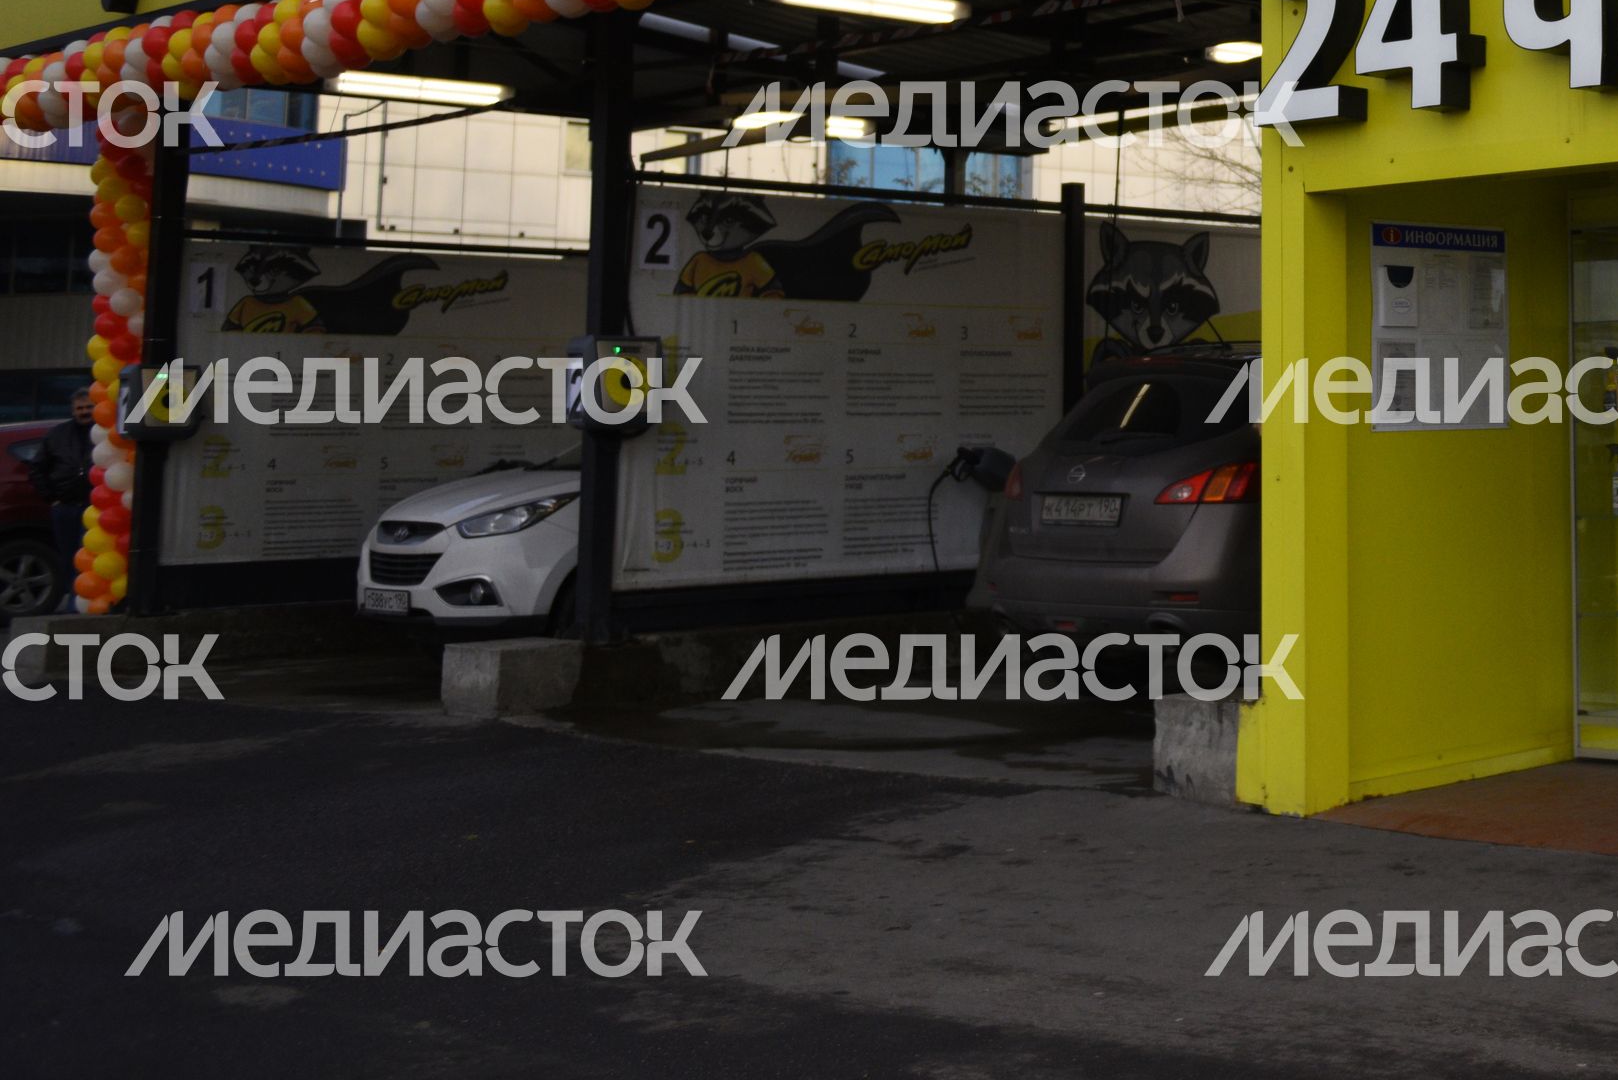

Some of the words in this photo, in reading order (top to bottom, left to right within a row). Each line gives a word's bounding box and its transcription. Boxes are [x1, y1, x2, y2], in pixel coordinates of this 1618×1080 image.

[643, 213, 673, 264] 2
[1405, 228, 1499, 249] ИНФОРМАЦИЯ
[197, 266, 215, 309] 1
[848, 323, 857, 338] 2
[959, 325, 969, 341] 3
[266, 457, 277, 470] 4
[379, 456, 389, 470] 5
[726, 450, 736, 465] 4
[845, 448, 855, 465] 5
